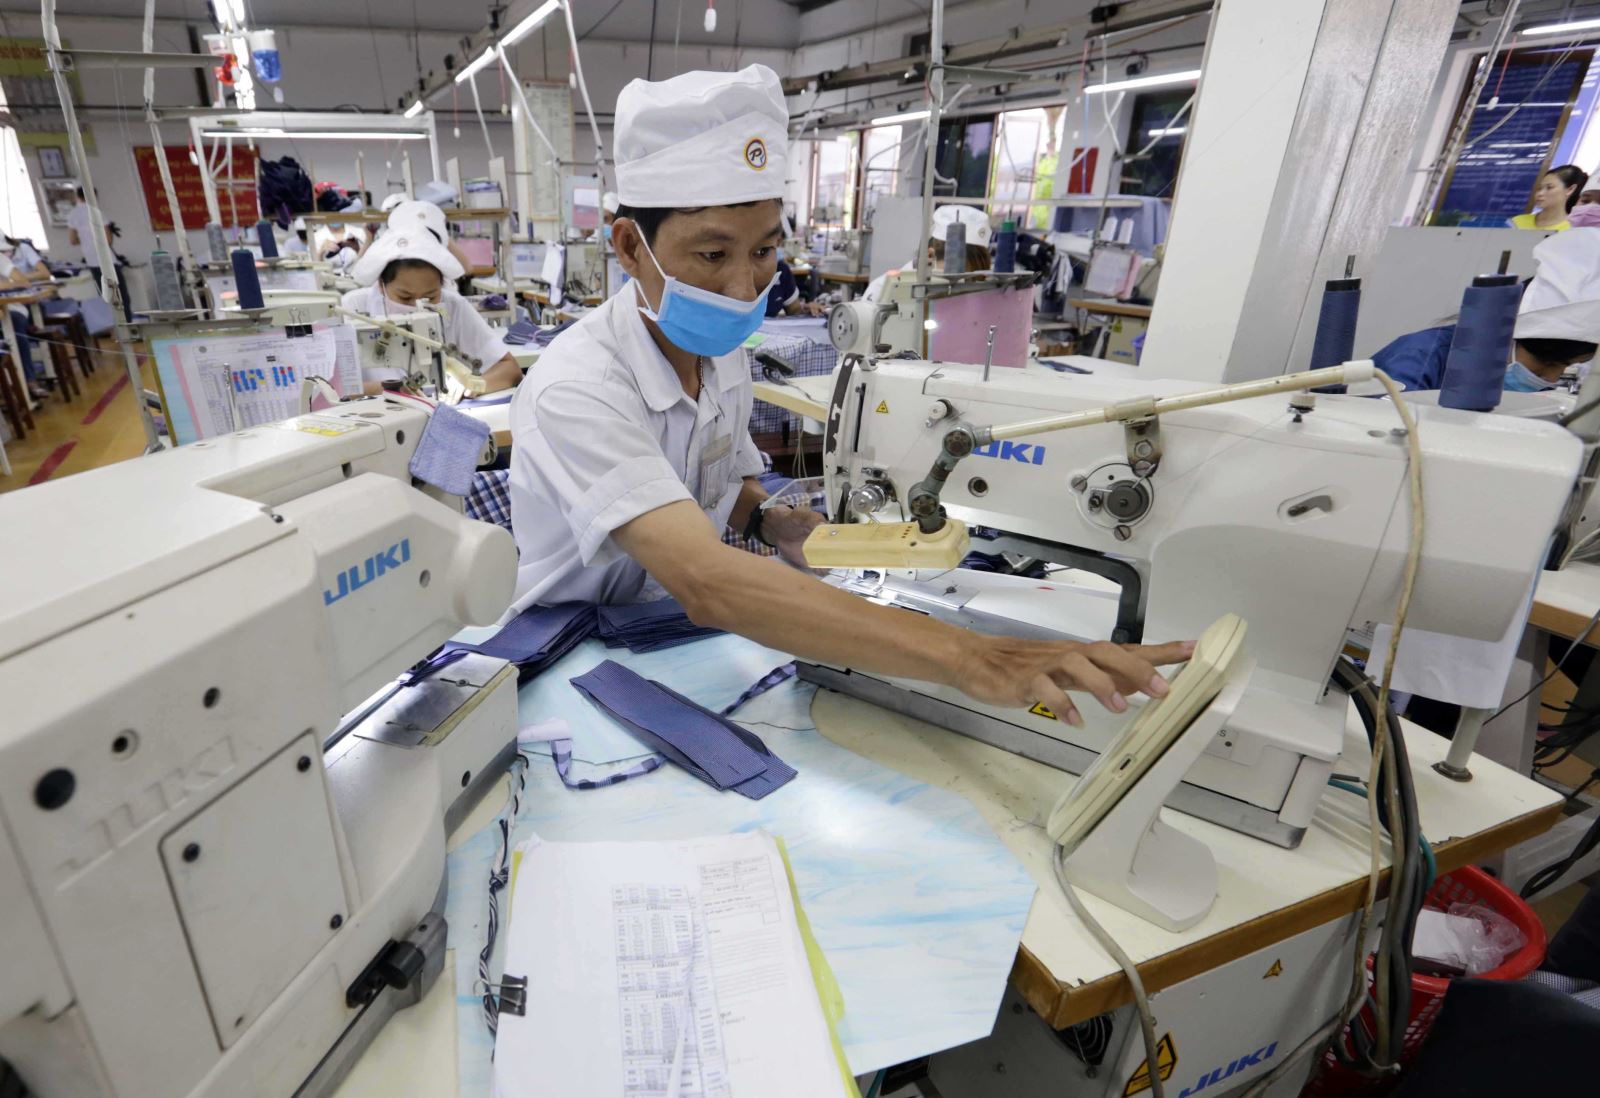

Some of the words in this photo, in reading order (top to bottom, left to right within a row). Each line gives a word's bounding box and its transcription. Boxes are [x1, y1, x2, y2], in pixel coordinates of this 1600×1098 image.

[971, 440, 1045, 465] UKI
[323, 538, 410, 606] JUKI
[1178, 1041, 1278, 1098] JUKI
